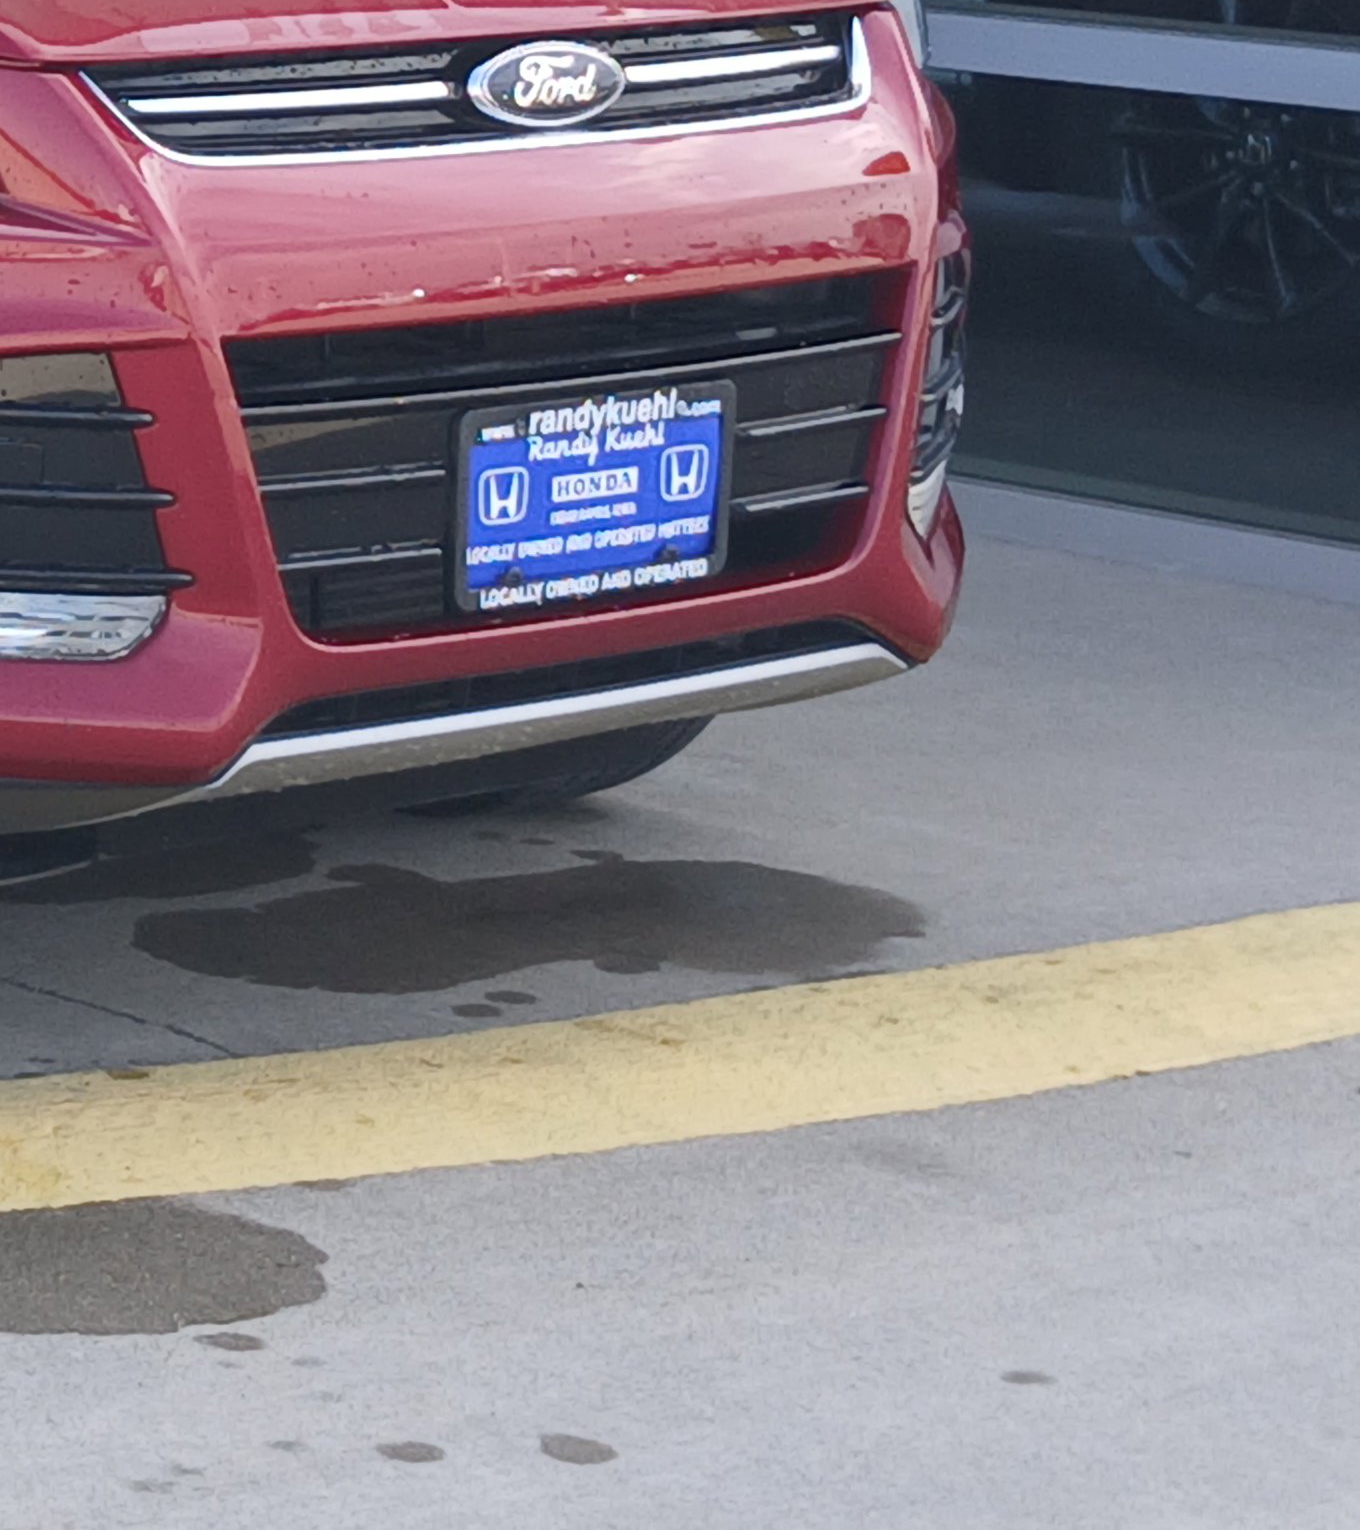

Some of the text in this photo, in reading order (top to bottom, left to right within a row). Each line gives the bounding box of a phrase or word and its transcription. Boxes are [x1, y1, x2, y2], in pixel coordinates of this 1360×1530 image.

[513, 54, 597, 108] Ford
[527, 432, 598, 466] Randy
[604, 422, 666, 452] Kuehl
[556, 472, 632, 497] HONDA
[480, 558, 708, 610] LOCALLY OWNED AND OPERATED
